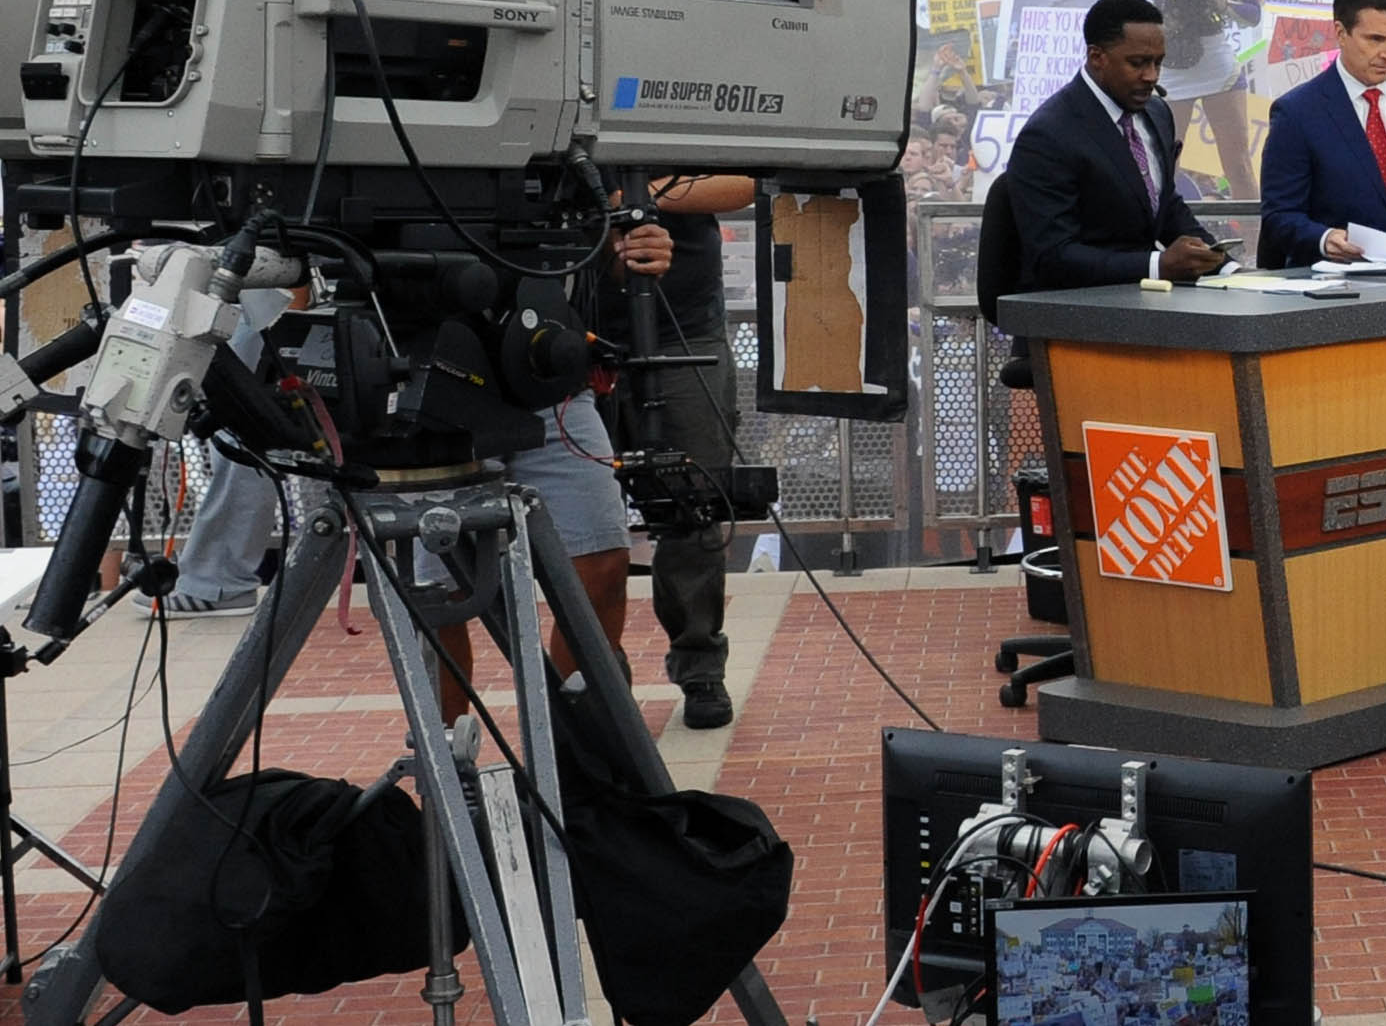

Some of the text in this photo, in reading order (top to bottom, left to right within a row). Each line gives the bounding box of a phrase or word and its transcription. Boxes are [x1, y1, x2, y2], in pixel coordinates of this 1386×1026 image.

[493, 8, 540, 23] SONY
[610, 5, 685, 22] IMAGE STABILIZER
[771, 17, 809, 32] Canon
[1022, 10, 1072, 32] HIDE YO
[1019, 33, 1069, 55] HIDE YO
[1017, 56, 1082, 76] CUZ RICHM
[640, 79, 668, 100] DIGI
[668, 80, 713, 102] SUPER
[1014, 77, 1064, 96] IS GONN
[1103, 445, 1154, 502] THE
[1099, 434, 1213, 576] HOME
[1147, 492, 1220, 581] DEPOT
